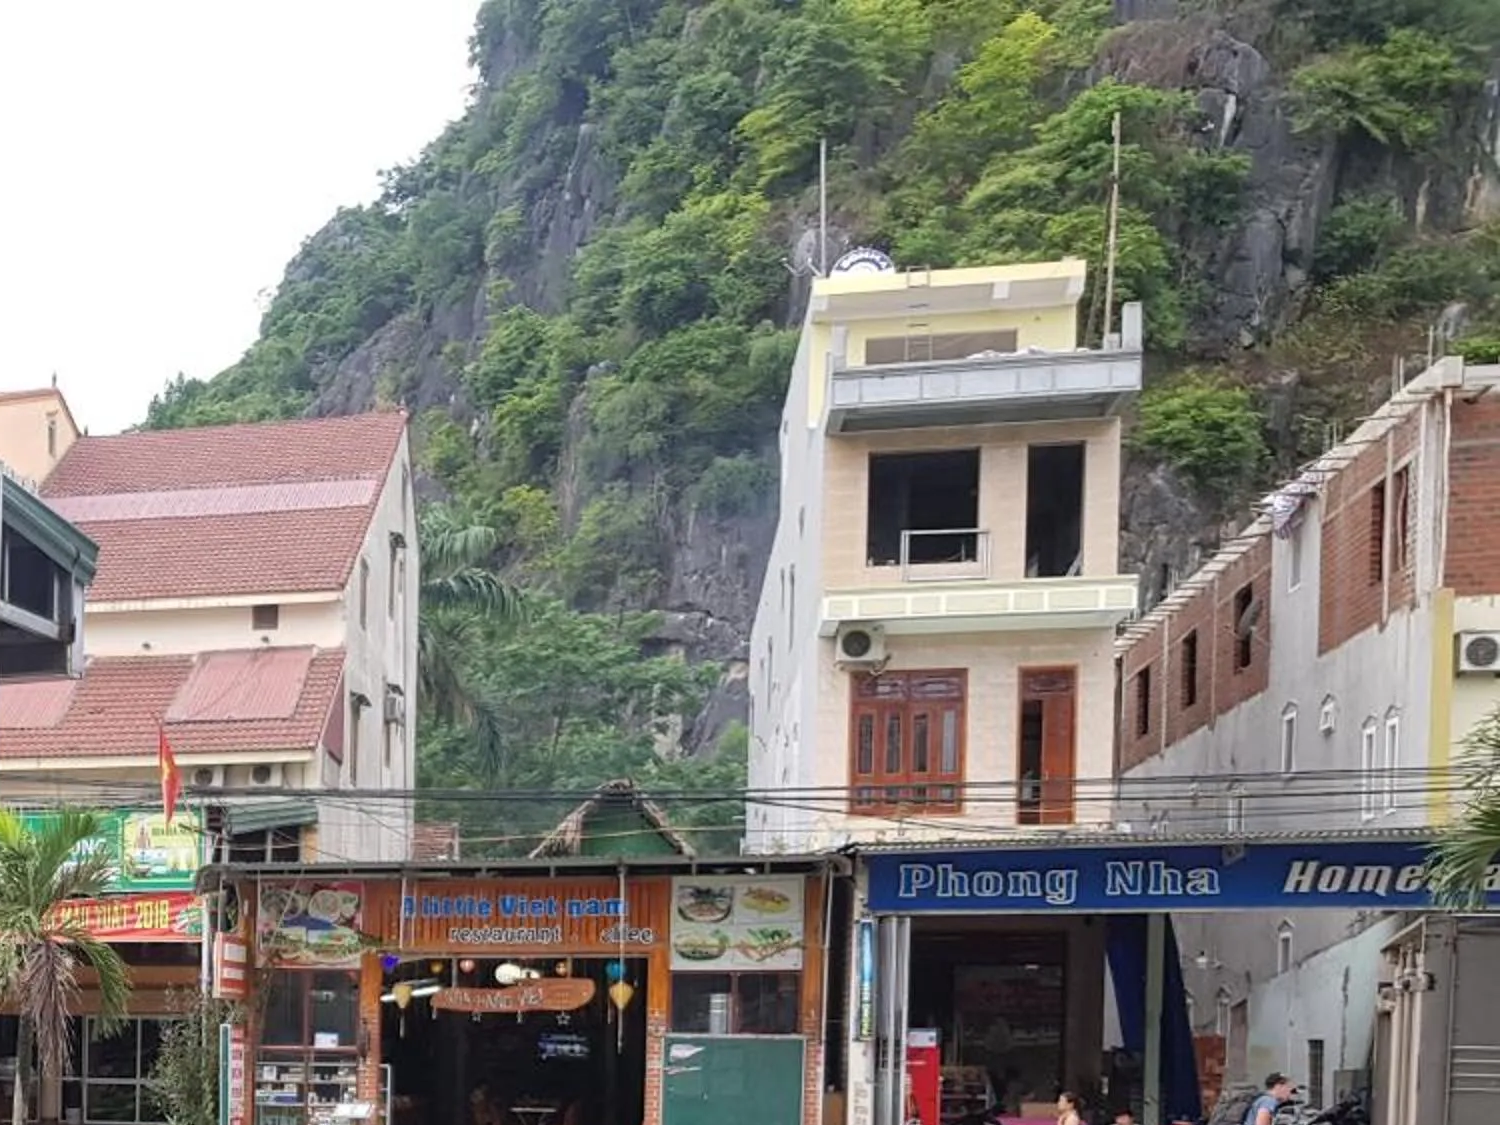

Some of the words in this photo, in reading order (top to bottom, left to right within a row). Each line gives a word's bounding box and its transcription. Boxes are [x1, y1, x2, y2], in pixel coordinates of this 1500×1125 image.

[898, 863, 1079, 905] Phong
[1106, 861, 1221, 896] Nha
[499, 895, 557, 917] Viet
[448, 925, 562, 945] restaurant
